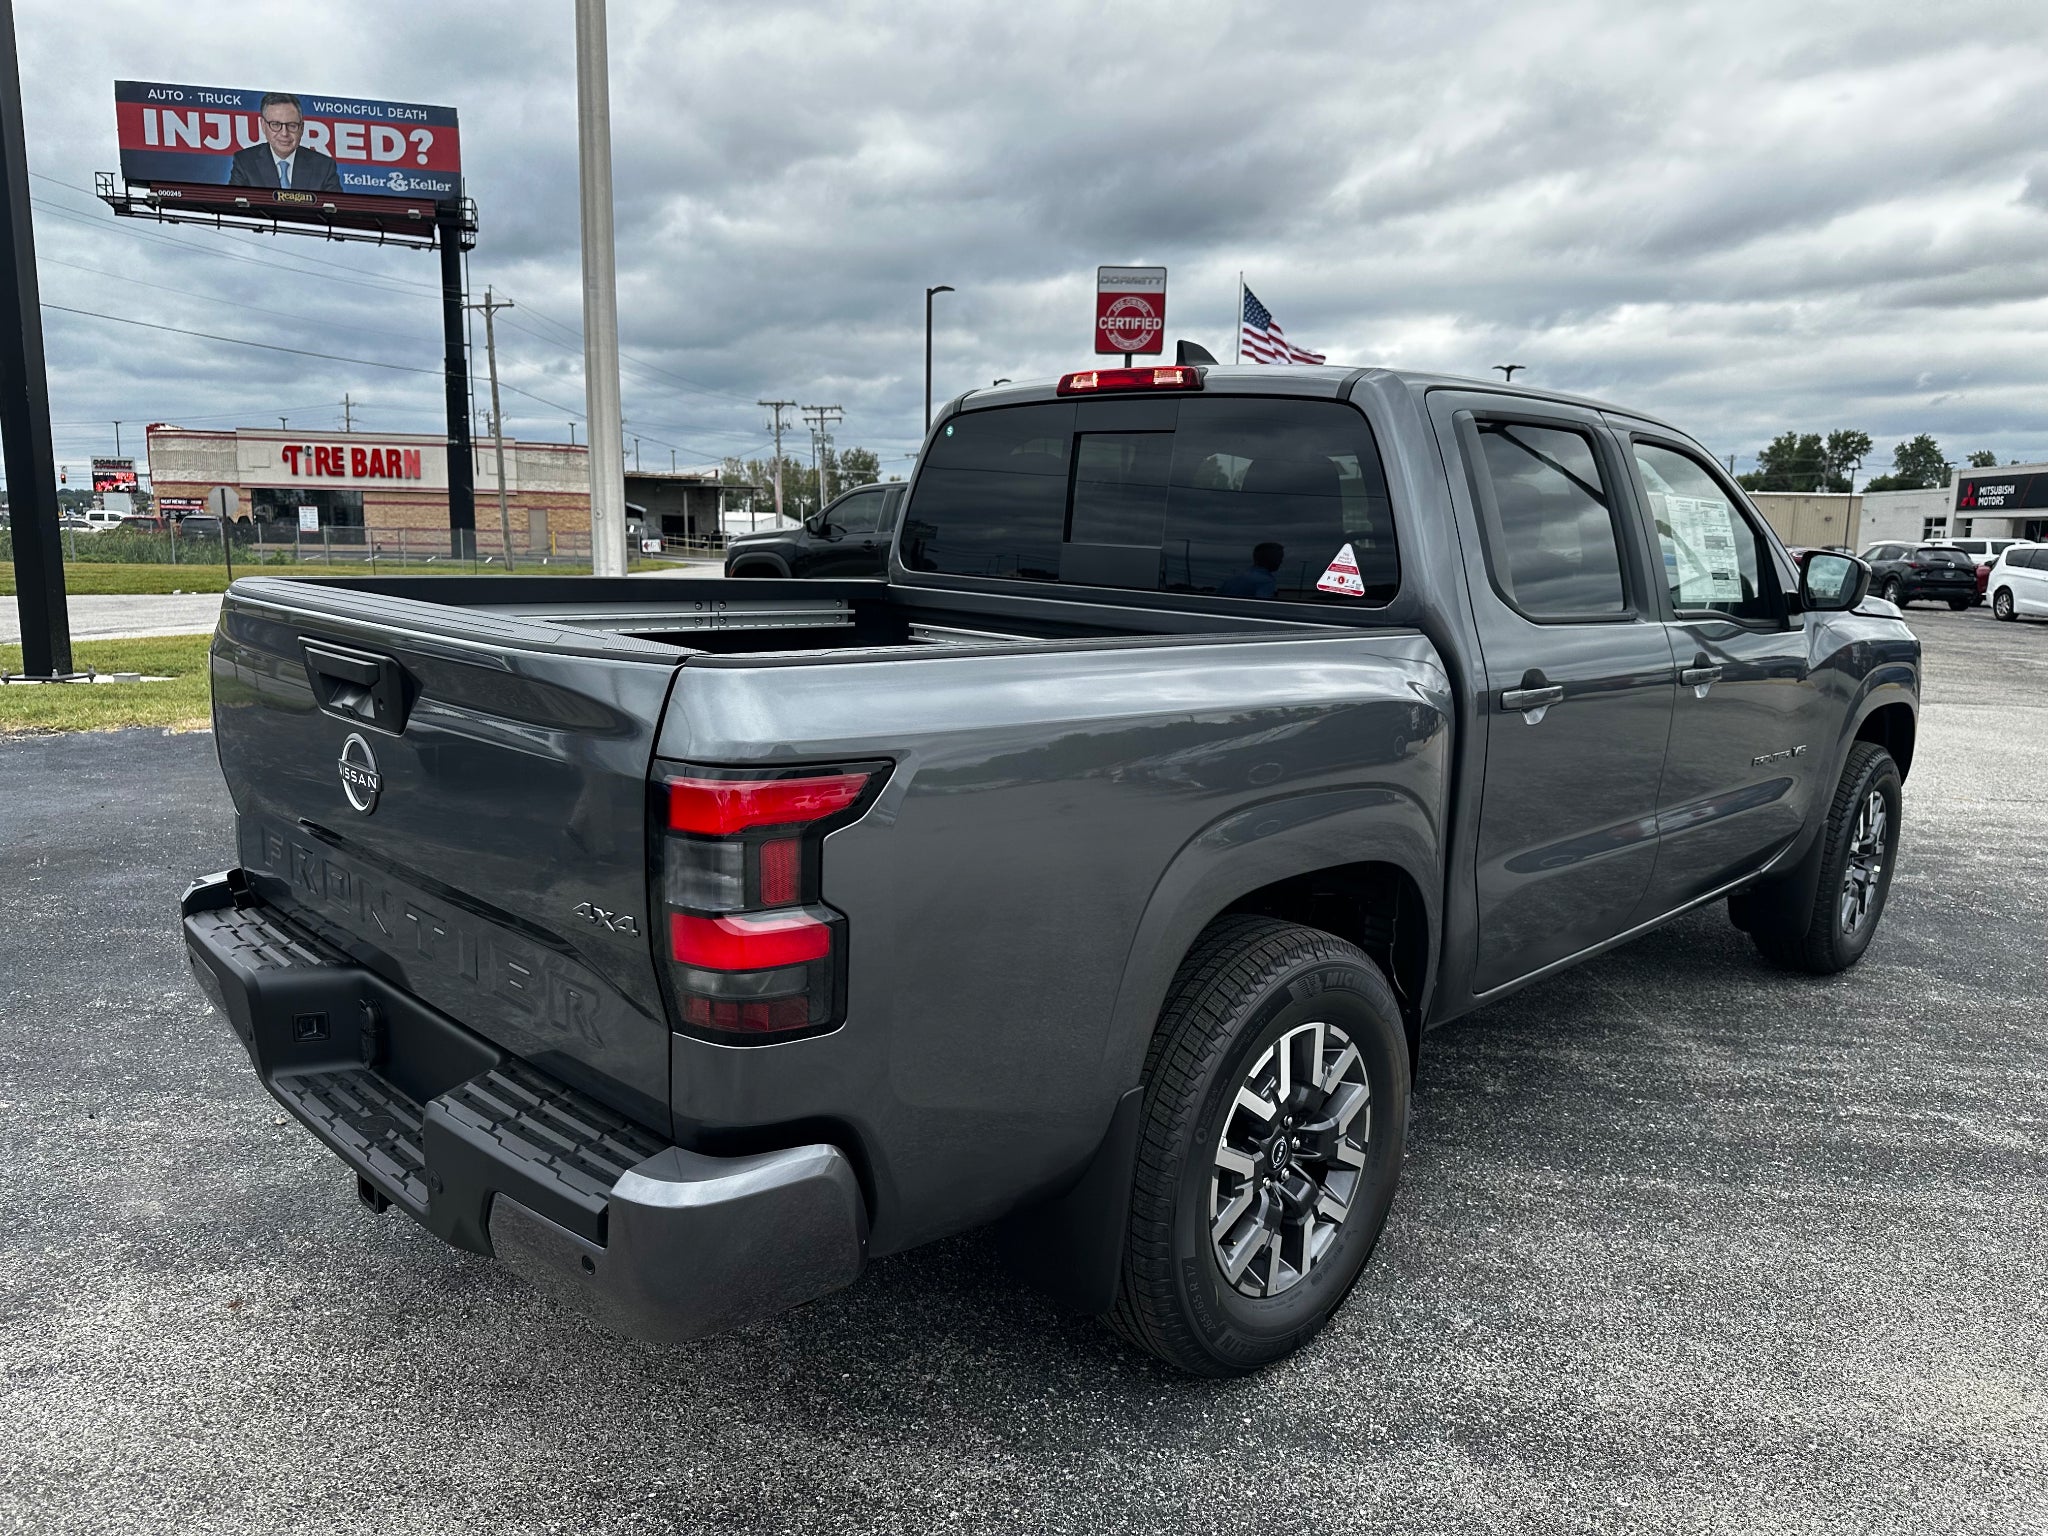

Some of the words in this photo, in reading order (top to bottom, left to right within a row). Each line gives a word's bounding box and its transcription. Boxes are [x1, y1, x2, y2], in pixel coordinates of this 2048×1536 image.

[148, 88, 183, 101] AUTO
[198, 92, 242, 106] TRUCK
[313, 102, 384, 117] WRONGFUL
[387, 108, 427, 121] DEATH
[143, 108, 434, 166] INJURED?
[277, 190, 313, 204] Reagan
[1099, 316, 1163, 330] CERTIFIED
[351, 447, 421, 479] BARN
[1979, 485, 2015, 496] MITSUBISHI
[1978, 496, 2004, 506] MOTORS
[338, 762, 377, 790] NISSAN
[261, 826, 606, 1049] FRONTIER
